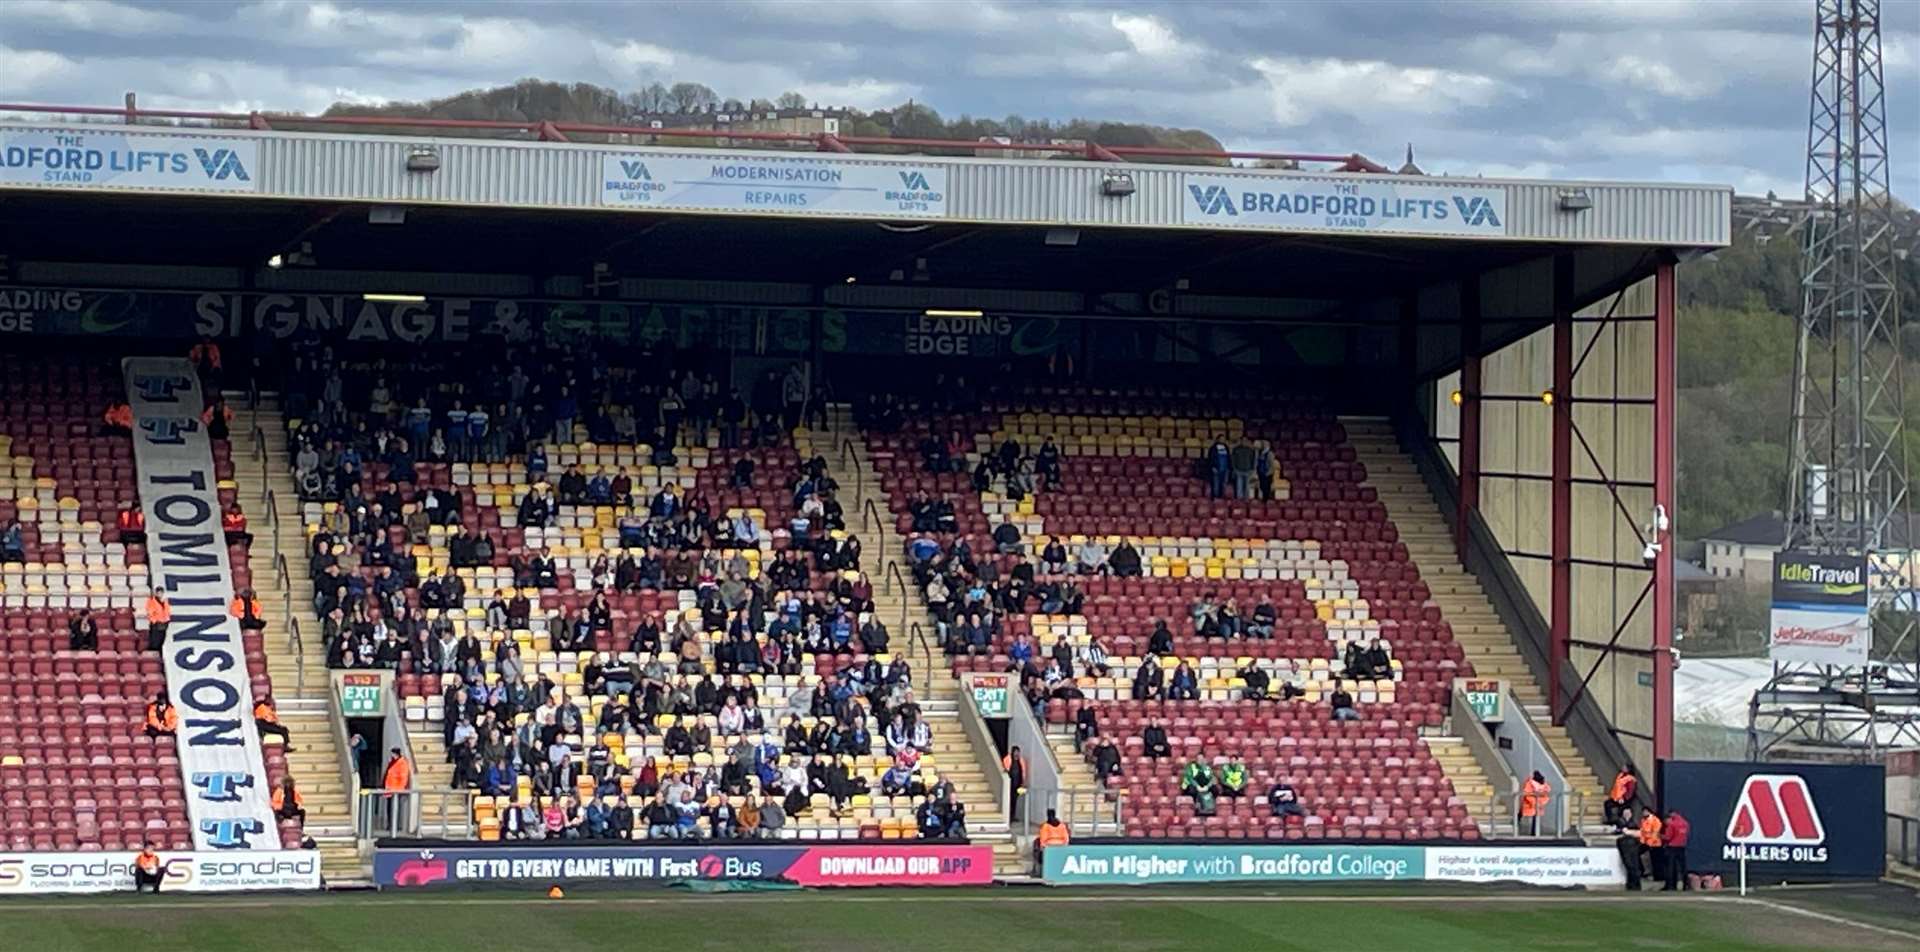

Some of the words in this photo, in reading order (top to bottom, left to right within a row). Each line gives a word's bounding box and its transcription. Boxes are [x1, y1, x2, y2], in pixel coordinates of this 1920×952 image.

[54, 135, 84, 147] THE
[0, 146, 103, 170] DFORD
[110, 150, 188, 173] LIFTS
[44, 171, 92, 182] STAND
[712, 165, 842, 182] MODERNISATION
[606, 181, 666, 192] BRADFORD
[1334, 184, 1359, 195] THE
[744, 190, 807, 206] REPAIRS
[885, 191, 943, 202] BRADFORD
[1242, 192, 1375, 217] BRADFORD
[1382, 199, 1449, 220] LIFTS
[1325, 217, 1366, 228] STAND
[195, 292, 471, 343] SIGNAGE
[905, 317, 1012, 335] LEADING
[905, 335, 969, 355] EDGE
[1780, 563, 1860, 583] IdleTravel
[149, 470, 245, 747] TOMLINSON
[344, 686, 380, 699] EXIT
[974, 688, 1007, 701] EXIT
[1467, 692, 1498, 704] EXIT
[1439, 856, 1471, 865] Higher
[1722, 845, 1790, 861] MILLERS
[1792, 847, 1828, 862] OILS
[456, 859, 487, 878] GET
[488, 859, 510, 877] TO
[512, 858, 562, 878] EVERY
[564, 858, 610, 877] GAME
[612, 858, 654, 877] WITH
[661, 857, 698, 877] First
[726, 857, 762, 876] Bus
[820, 856, 905, 875] DOWNLOAD
[908, 856, 940, 875] OUR
[943, 858, 971, 873] APP
[1062, 855, 1108, 875] Aim
[1113, 855, 1187, 877] Higher
[1193, 855, 1235, 875] with
[1241, 855, 1332, 875] Bradford
[1337, 855, 1407, 880] College
